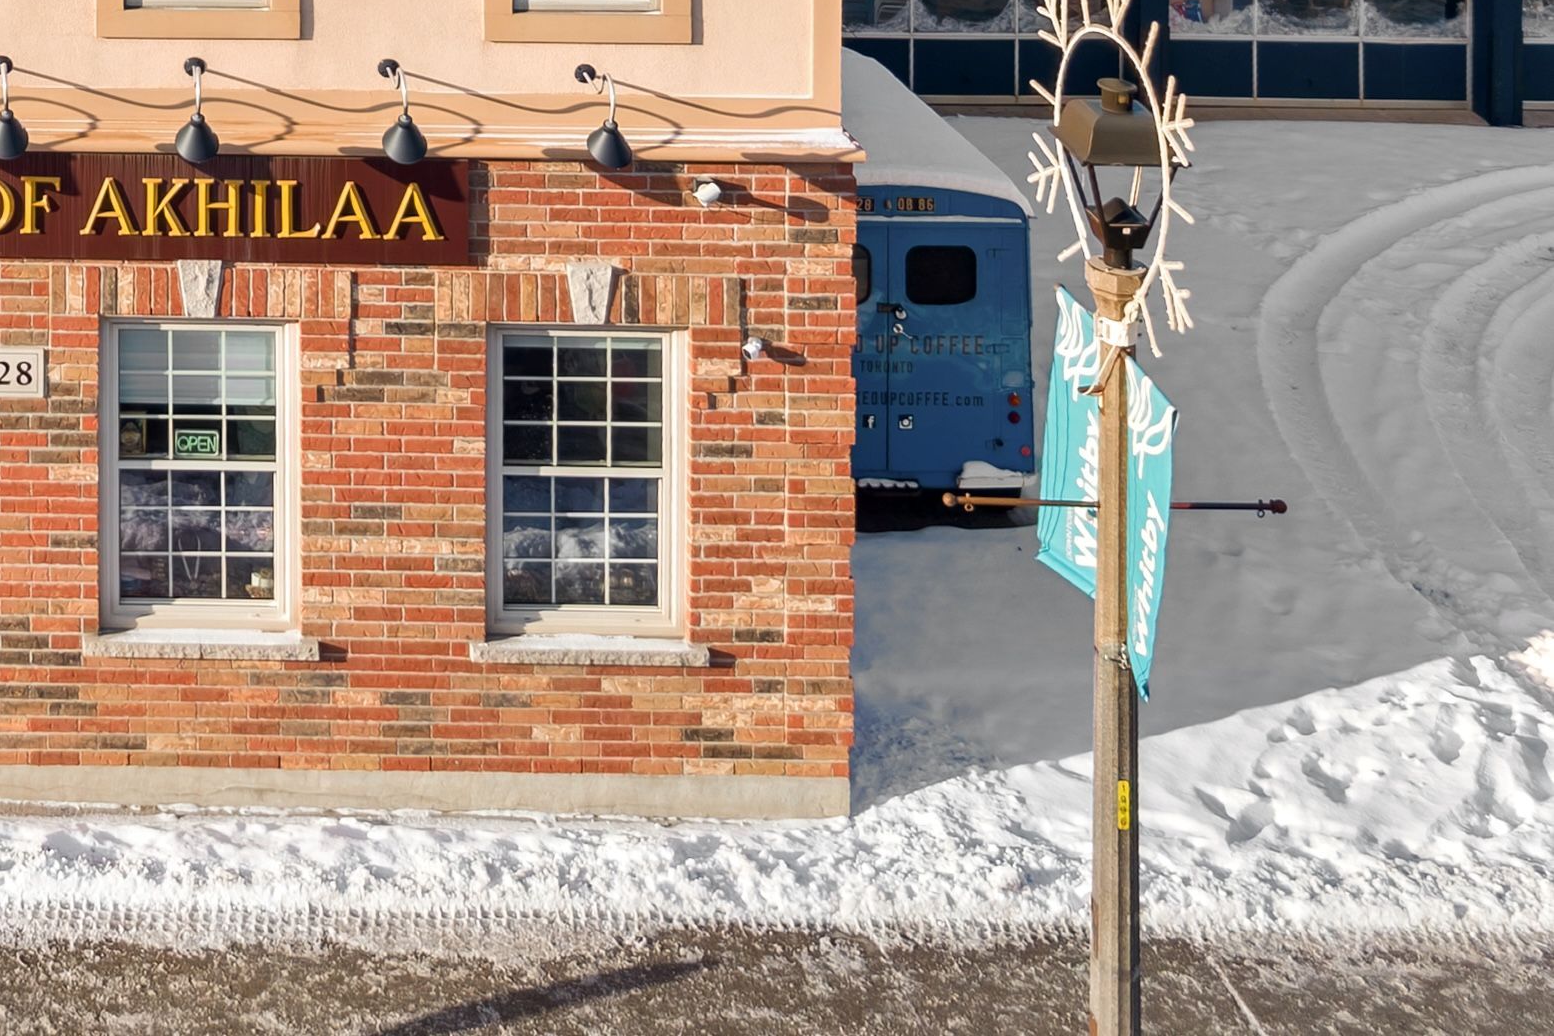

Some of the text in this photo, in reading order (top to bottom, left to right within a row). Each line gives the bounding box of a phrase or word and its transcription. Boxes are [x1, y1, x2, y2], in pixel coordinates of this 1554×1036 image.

[80, 175, 446, 242] AKHILAA
[876, 334, 899, 355] UP
[910, 334, 985, 355] COFFEE
[860, 360, 914, 373] TORONTO
[177, 434, 216, 452] OPEN
[1134, 489, 1165, 657] Whitby
